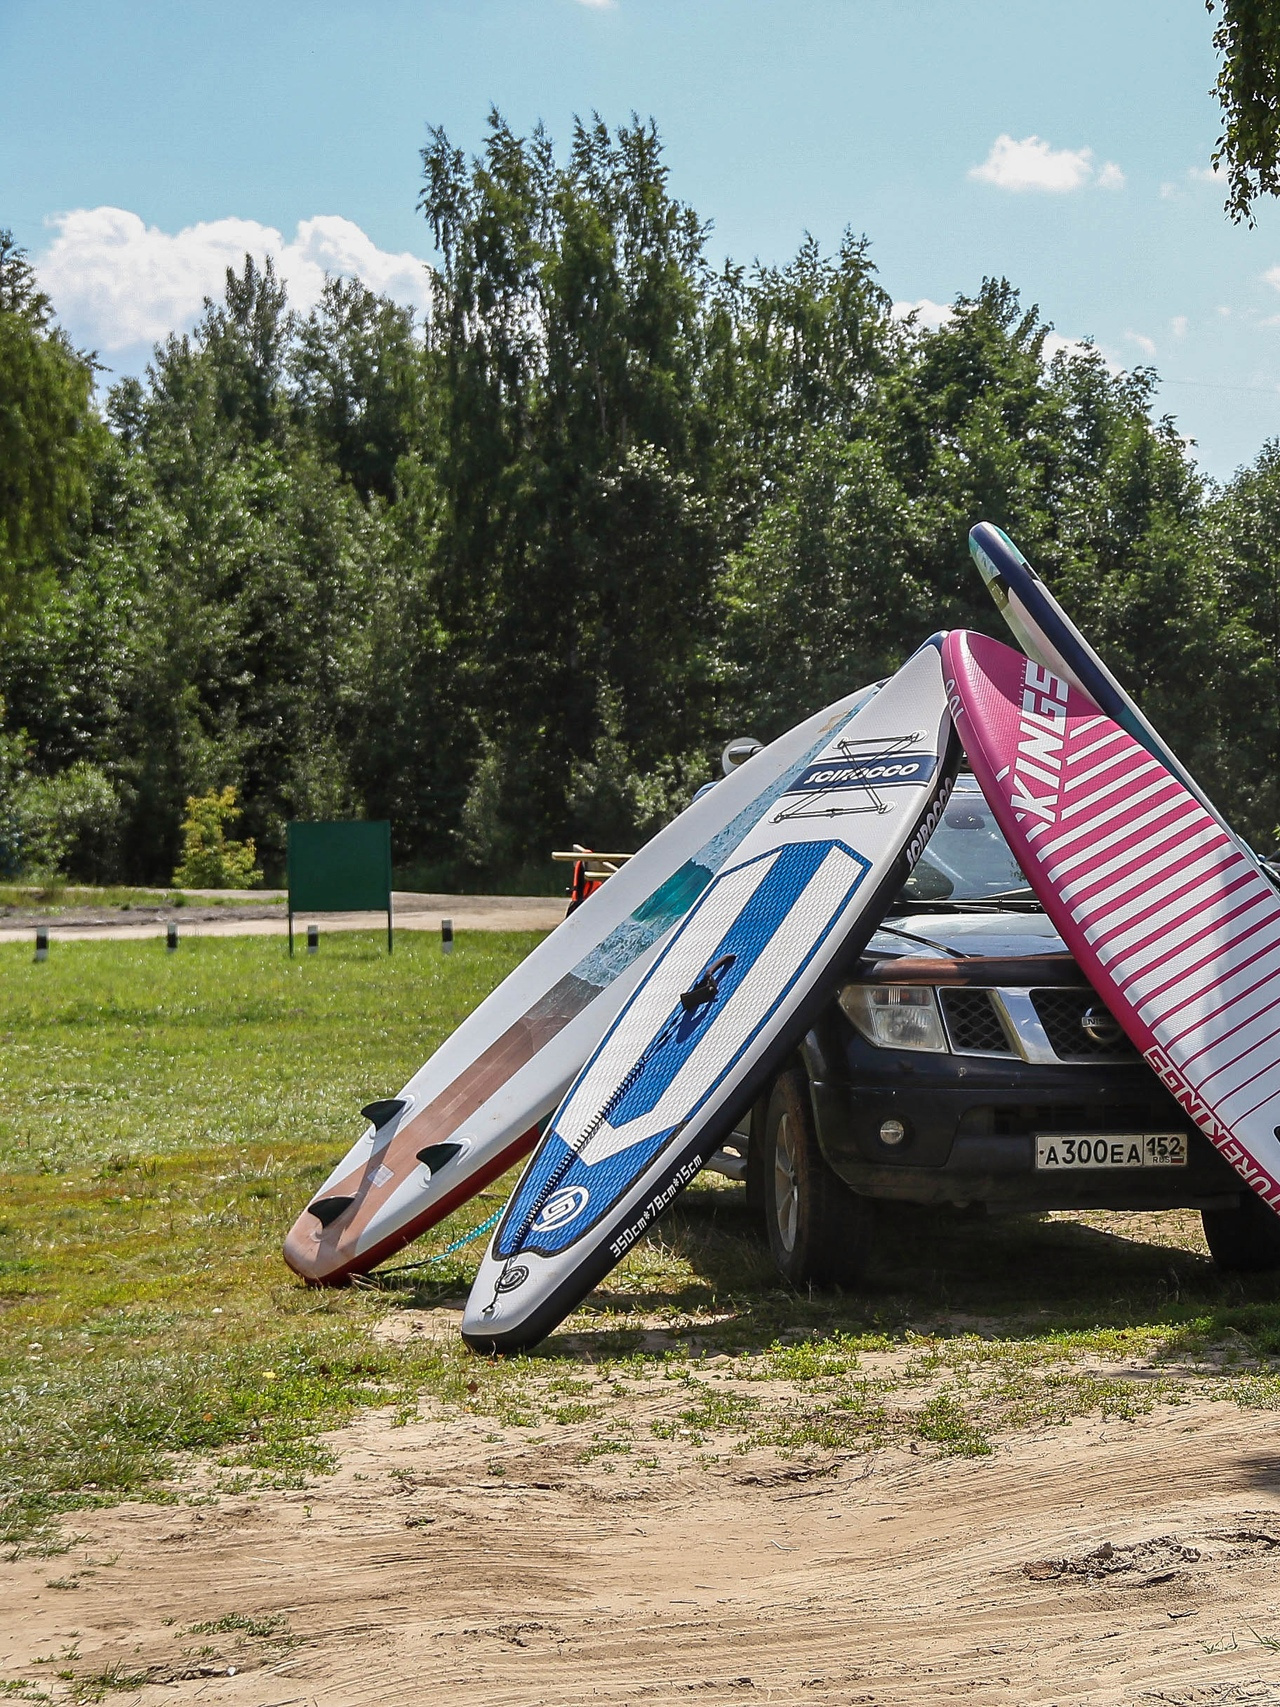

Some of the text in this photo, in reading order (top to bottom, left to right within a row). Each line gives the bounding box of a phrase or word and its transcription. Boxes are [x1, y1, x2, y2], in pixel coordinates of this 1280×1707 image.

[1010, 658, 1069, 824] KINGS
[803, 763, 919, 785] SCIROCCO
[1146, 1137, 1181, 1155] 152
